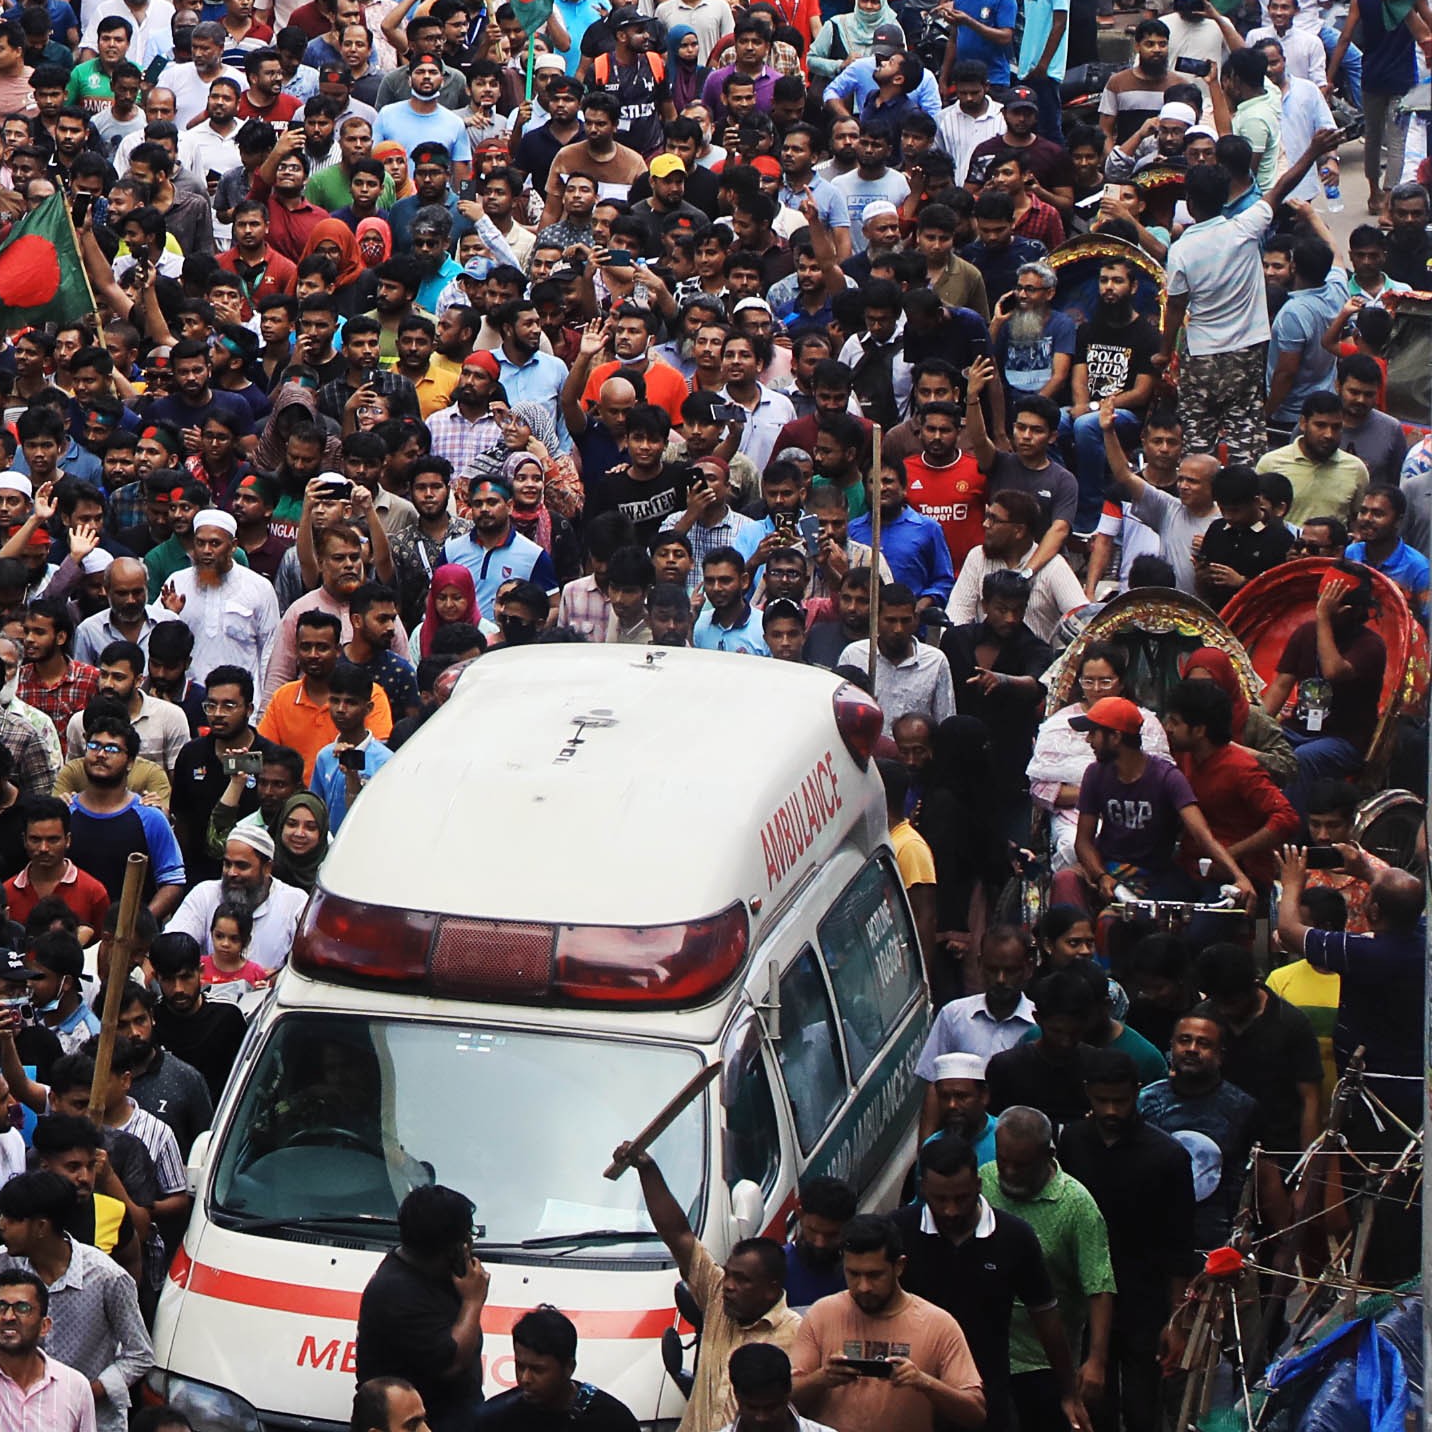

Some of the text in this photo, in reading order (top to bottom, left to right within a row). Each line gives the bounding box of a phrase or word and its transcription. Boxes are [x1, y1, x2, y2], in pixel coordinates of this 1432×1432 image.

[1090, 351, 1123, 364] POLO
[1088, 362, 1121, 375] CLUB
[919, 504, 953, 515] Team
[760, 752, 842, 891] AMBULANCE
